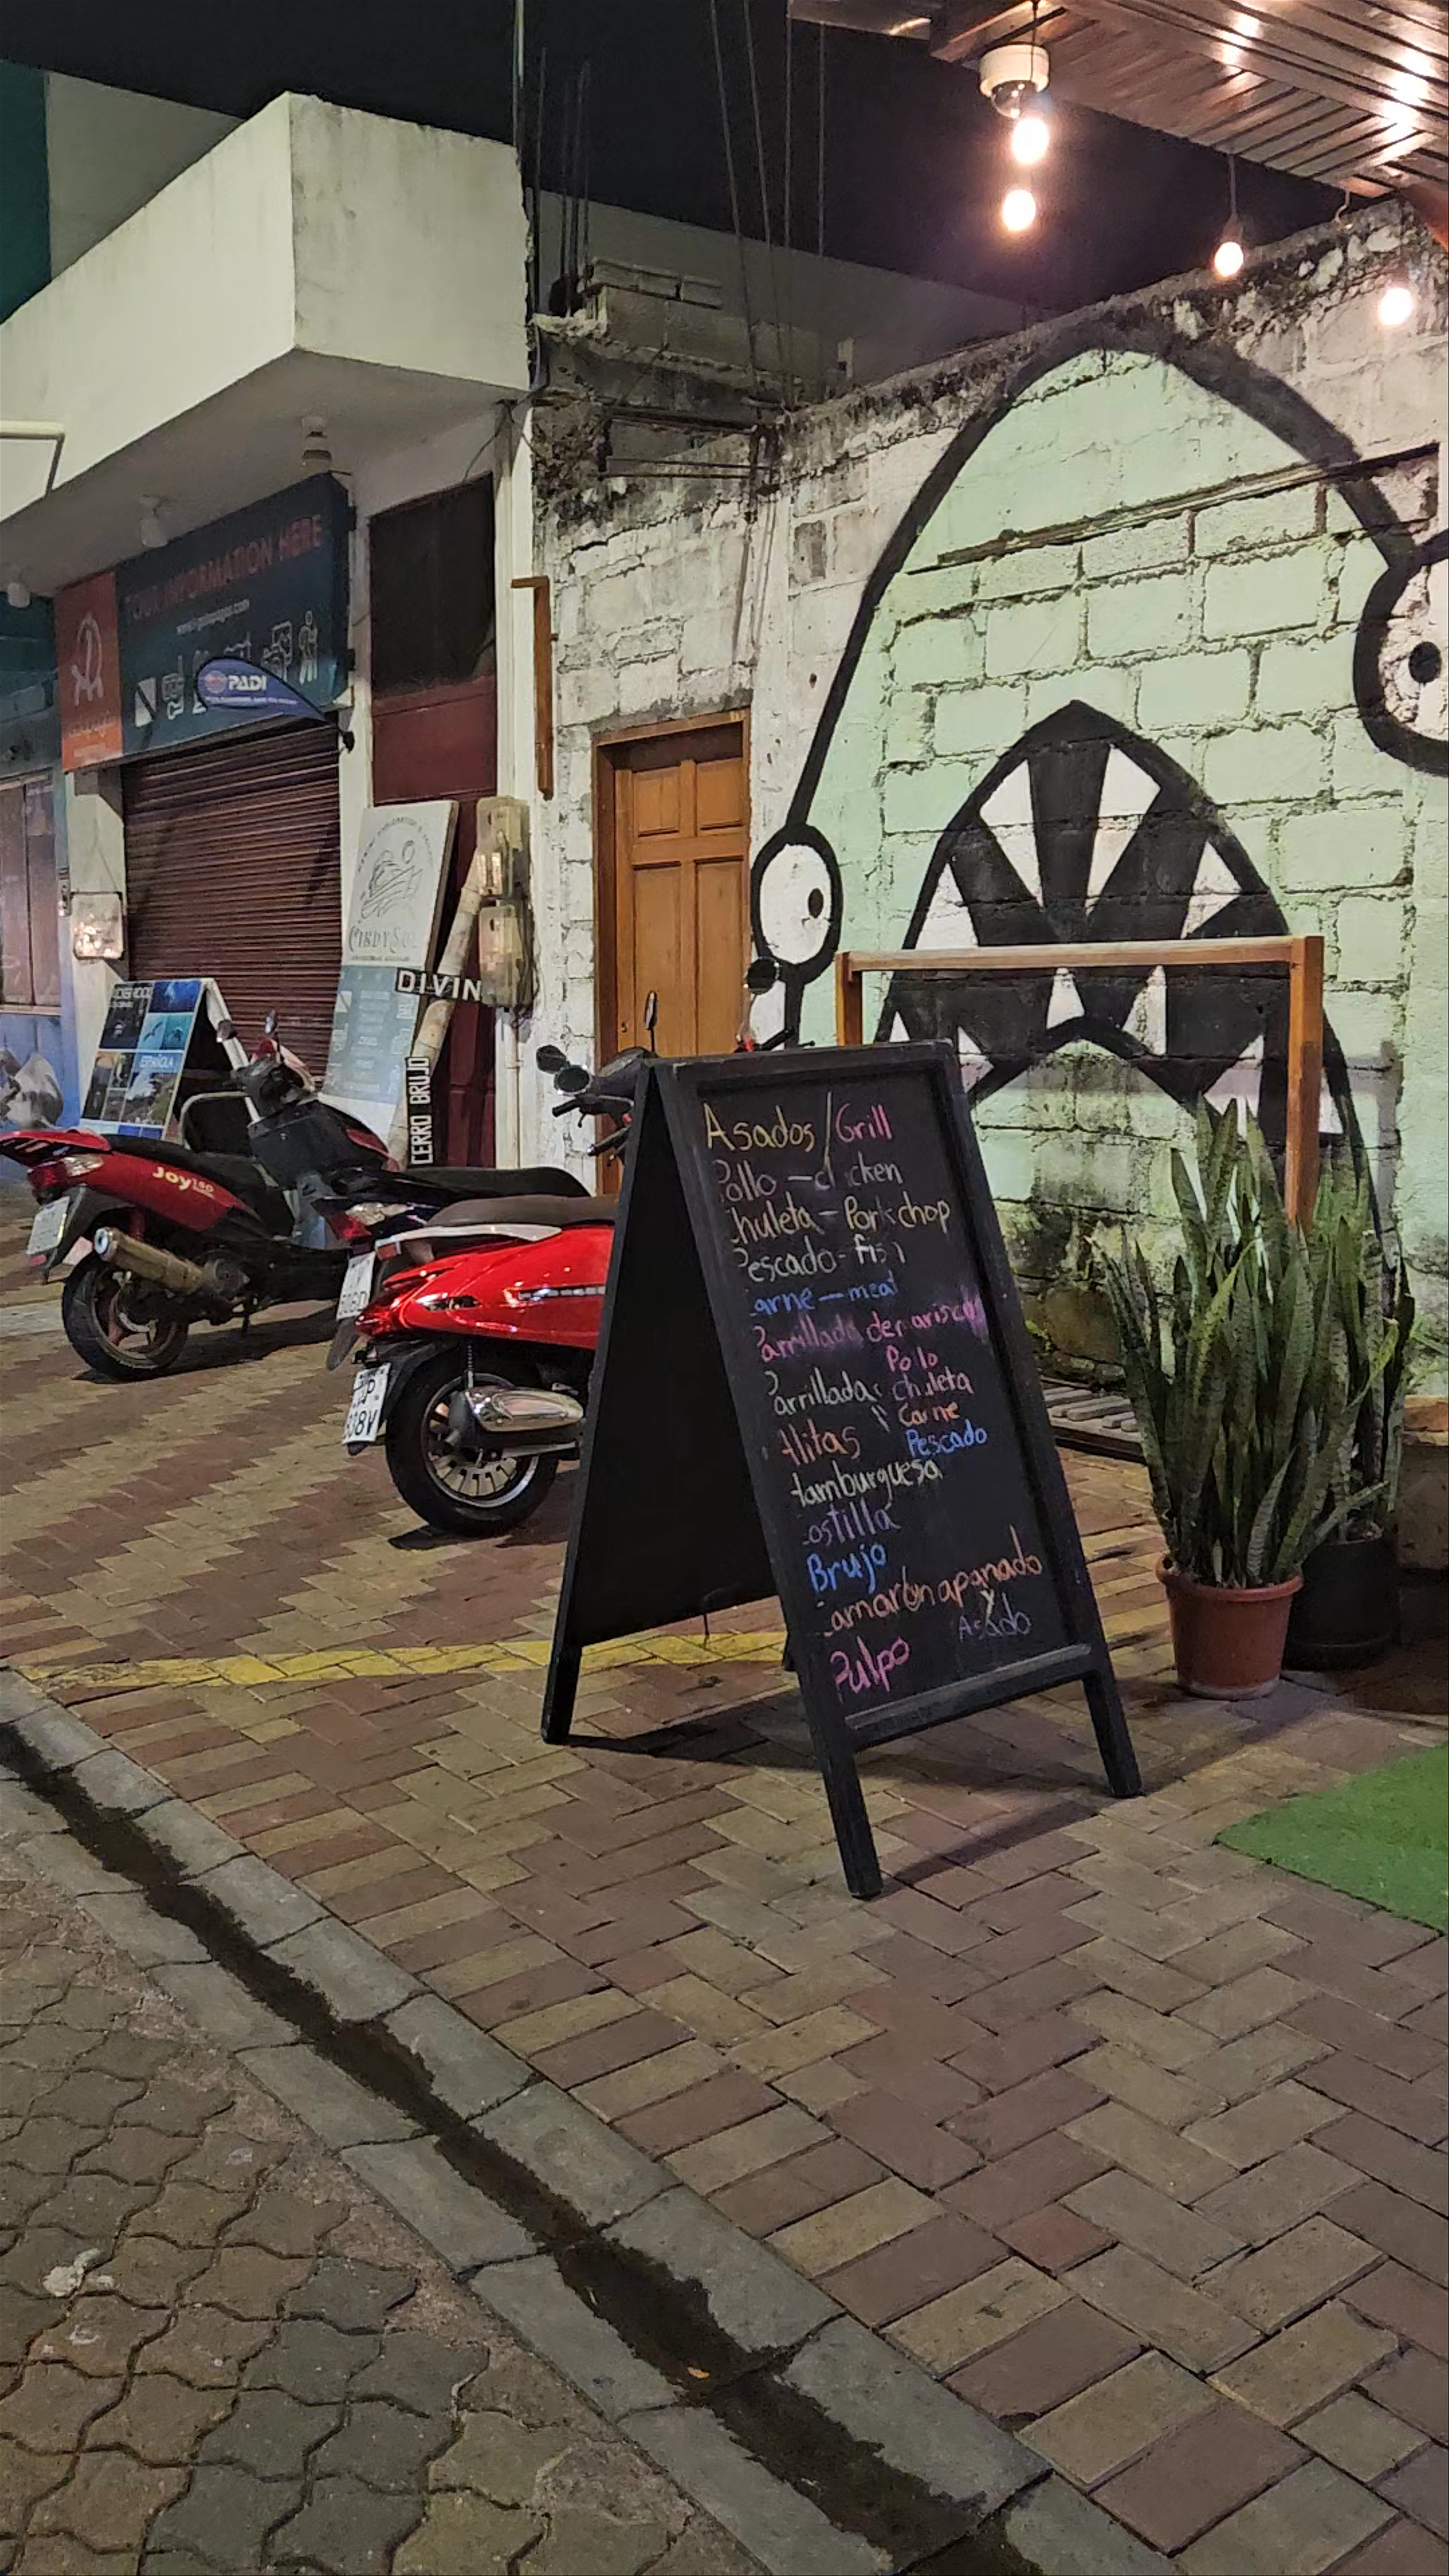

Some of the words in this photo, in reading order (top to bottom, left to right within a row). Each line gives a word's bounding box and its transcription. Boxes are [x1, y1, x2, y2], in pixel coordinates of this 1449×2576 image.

[228, 675, 267, 691] PADI
[407, 1058, 431, 1104] BRUJO
[410, 1115, 434, 1165] CERRO
[835, 1103, 893, 1143] Grill
[152, 1166, 192, 1191] Joy
[728, 1192, 826, 1244] huleta
[746, 1287, 816, 1317] arne
[801, 1497, 902, 1546] ostilla
